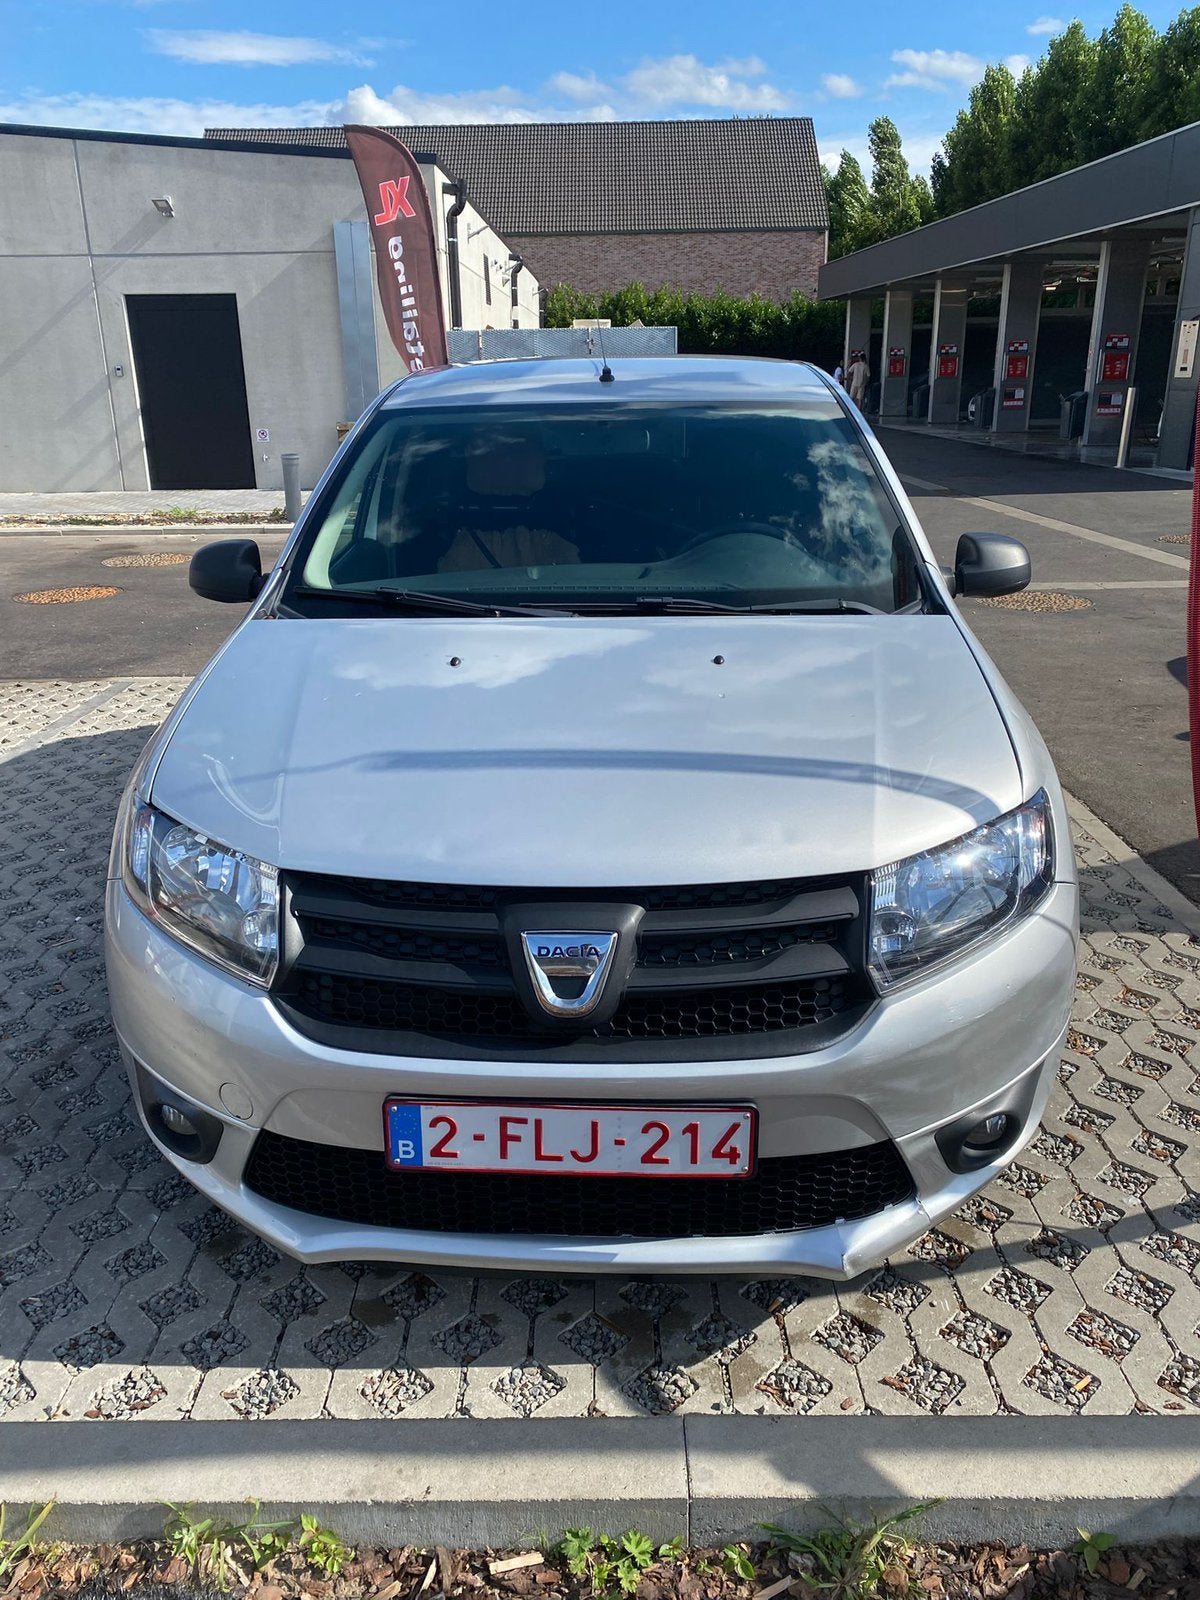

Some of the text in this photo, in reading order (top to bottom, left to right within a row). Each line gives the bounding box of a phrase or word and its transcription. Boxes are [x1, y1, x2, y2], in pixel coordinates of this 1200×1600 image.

[537, 945, 600, 958] DACIA
[398, 1140, 415, 1159] B
[428, 1115, 741, 1165] 2-FLJ-214
